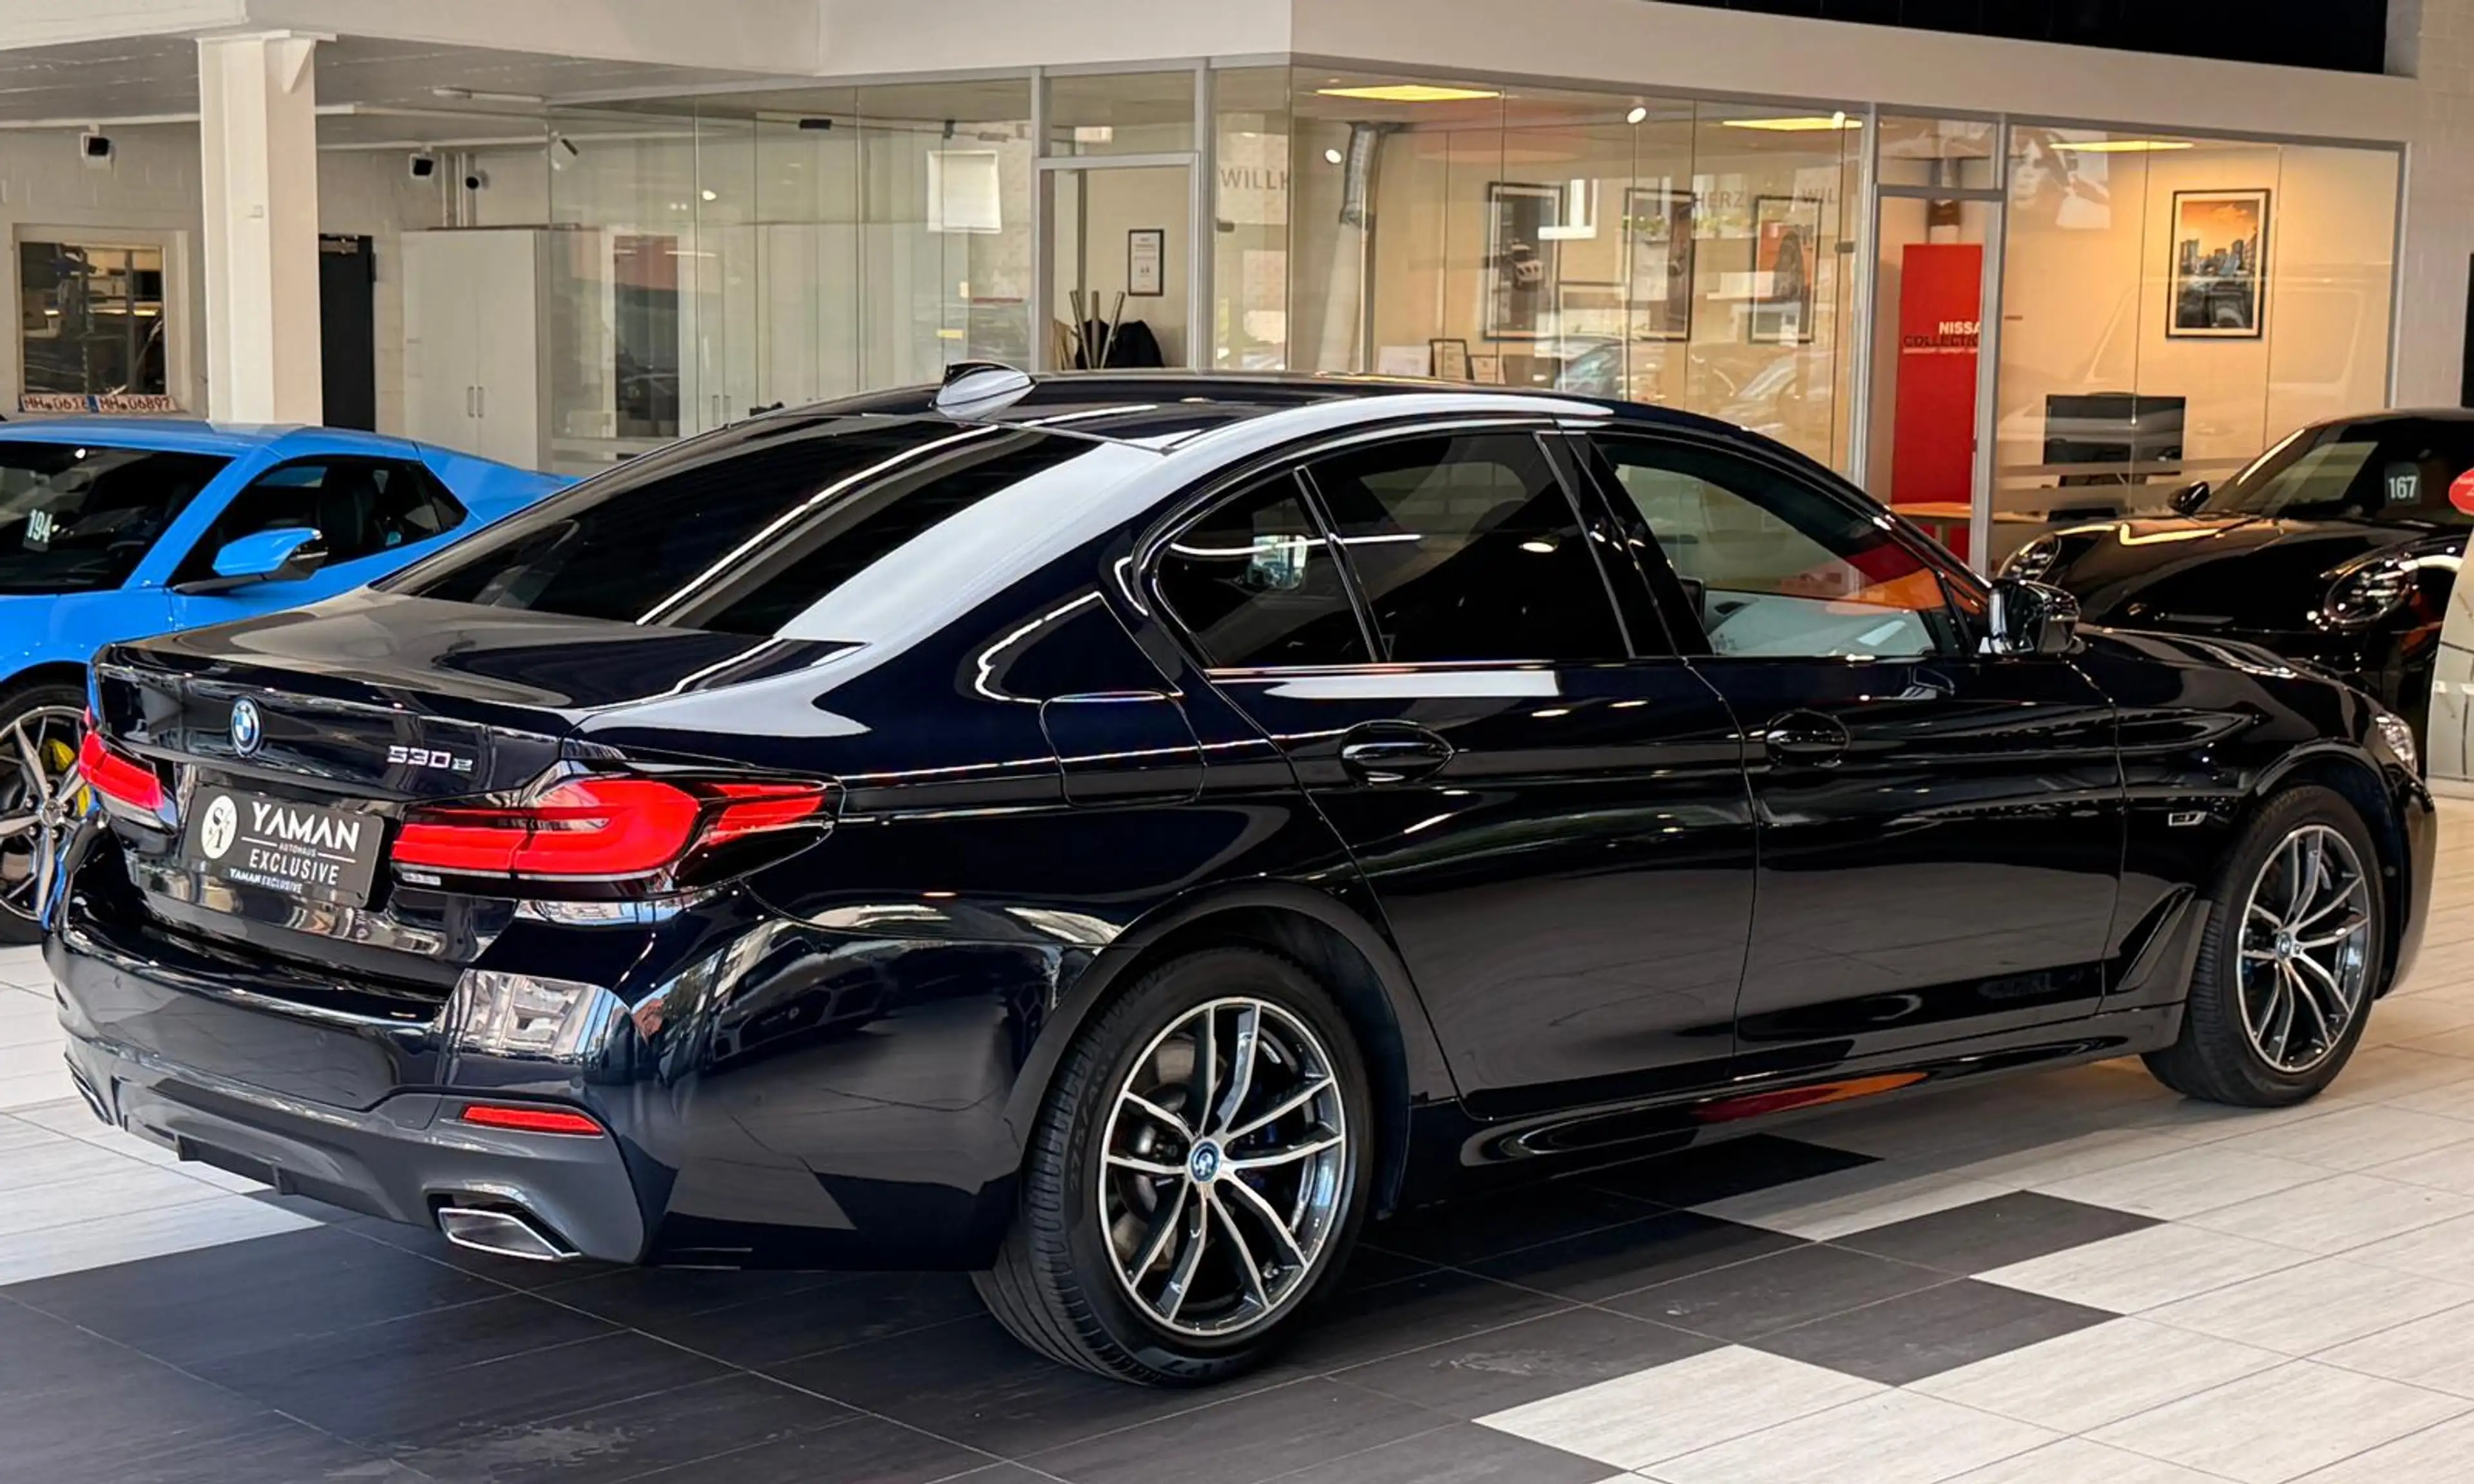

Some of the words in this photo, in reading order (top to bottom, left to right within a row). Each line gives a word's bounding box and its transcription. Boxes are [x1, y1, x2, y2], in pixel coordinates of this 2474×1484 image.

[2388, 475, 2417, 500] 167
[27, 508, 52, 543] 194
[251, 801, 360, 853] YAMAN
[278, 841, 318, 859] AUTOHAUS
[229, 867, 261, 884] YAMAN
[260, 875, 303, 894] EXCLUSIVE
[249, 848, 341, 886] EXCLUSIVE
